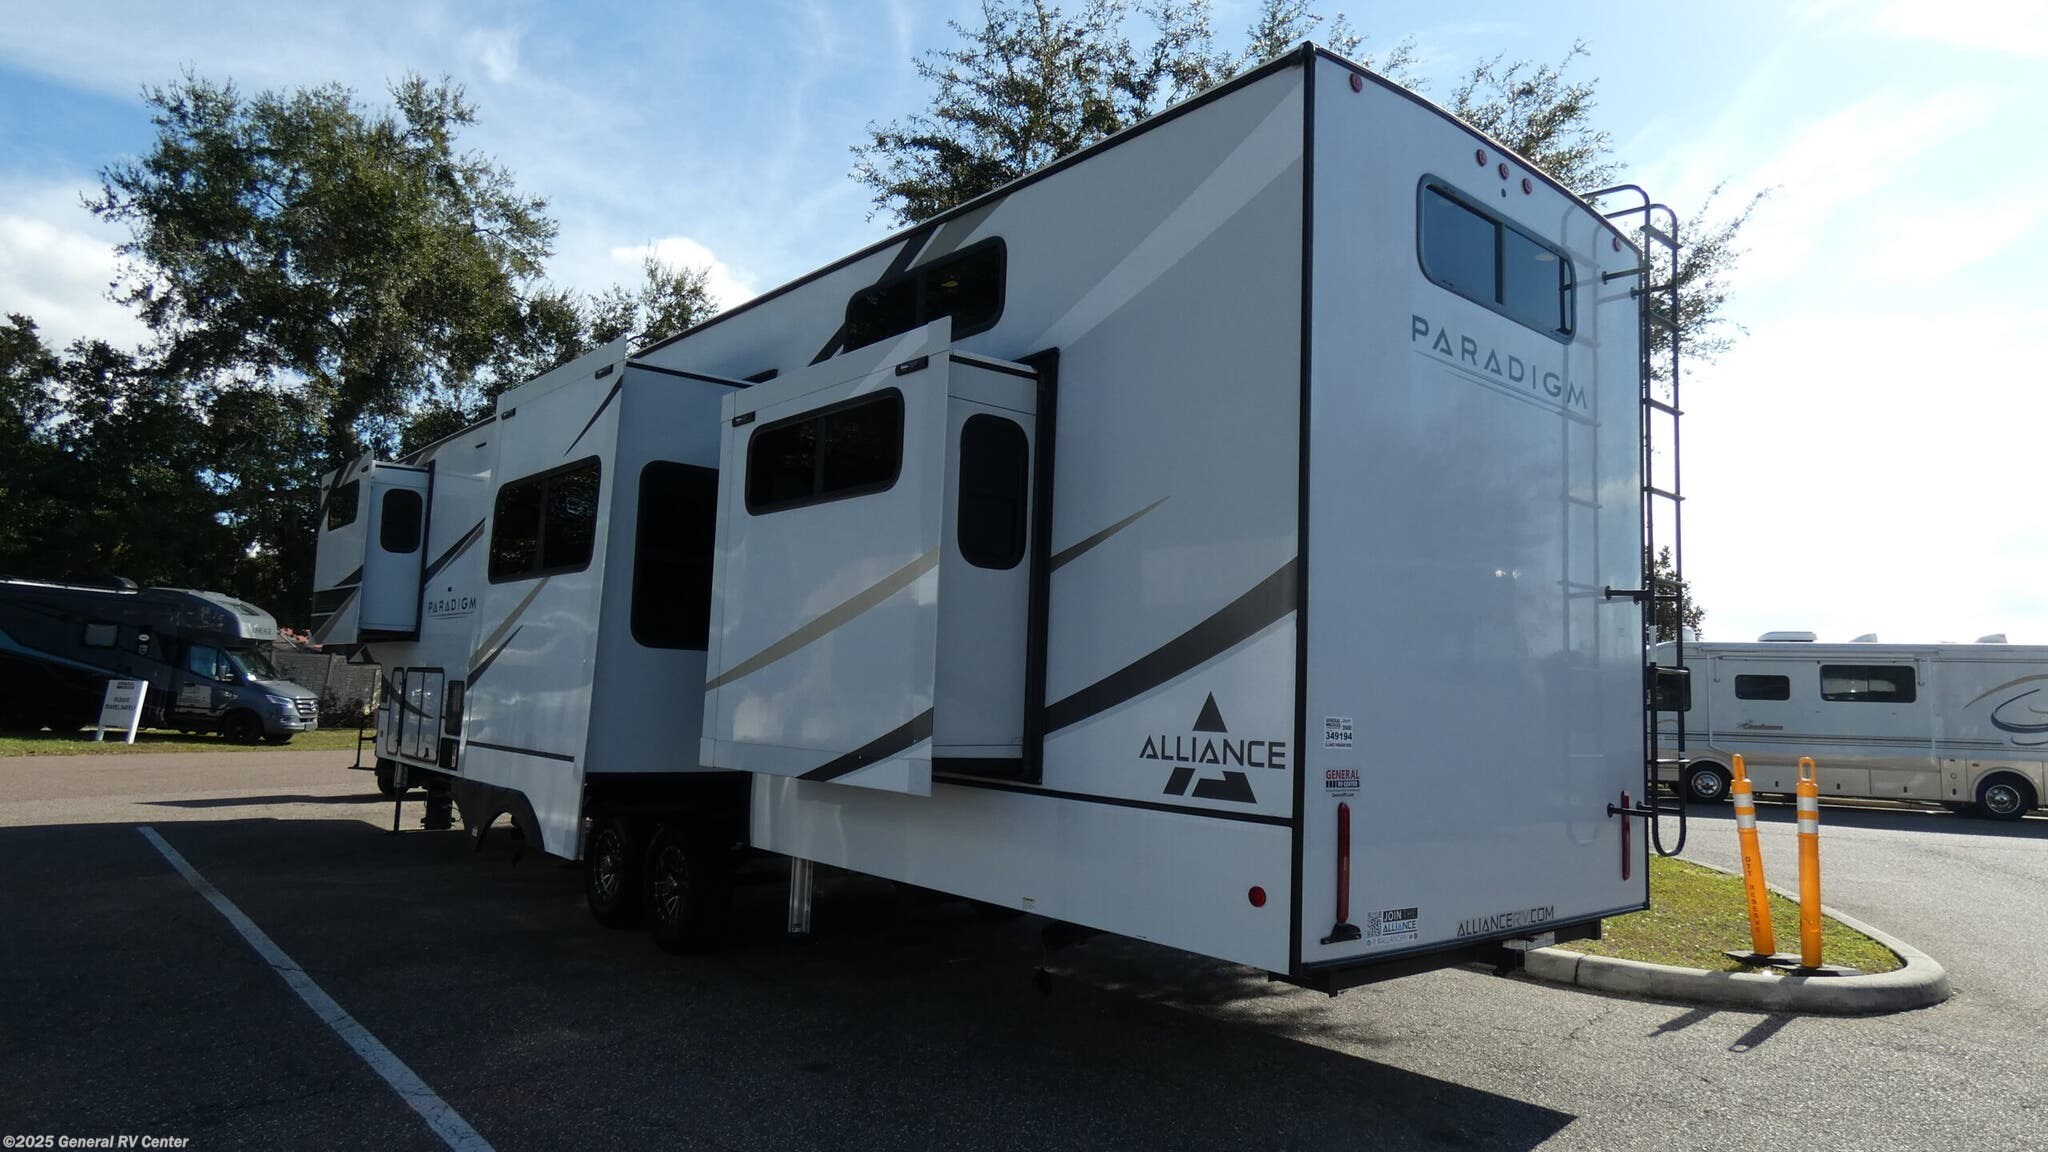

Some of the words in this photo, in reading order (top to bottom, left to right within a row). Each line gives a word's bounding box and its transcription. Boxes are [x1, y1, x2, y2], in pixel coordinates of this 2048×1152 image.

[1412, 314, 1588, 410] PARADIGM
[427, 597, 477, 613] PARADIGM
[1325, 731, 1352, 740] 349194
[1138, 735, 1287, 770] ALLIANCE
[1325, 769, 1360, 780] GENERAL
[1384, 910, 1402, 922] JOIN
[1457, 904, 1555, 938] ALLIANCERV.COM
[1383, 920, 1417, 932] ALLIANCE
